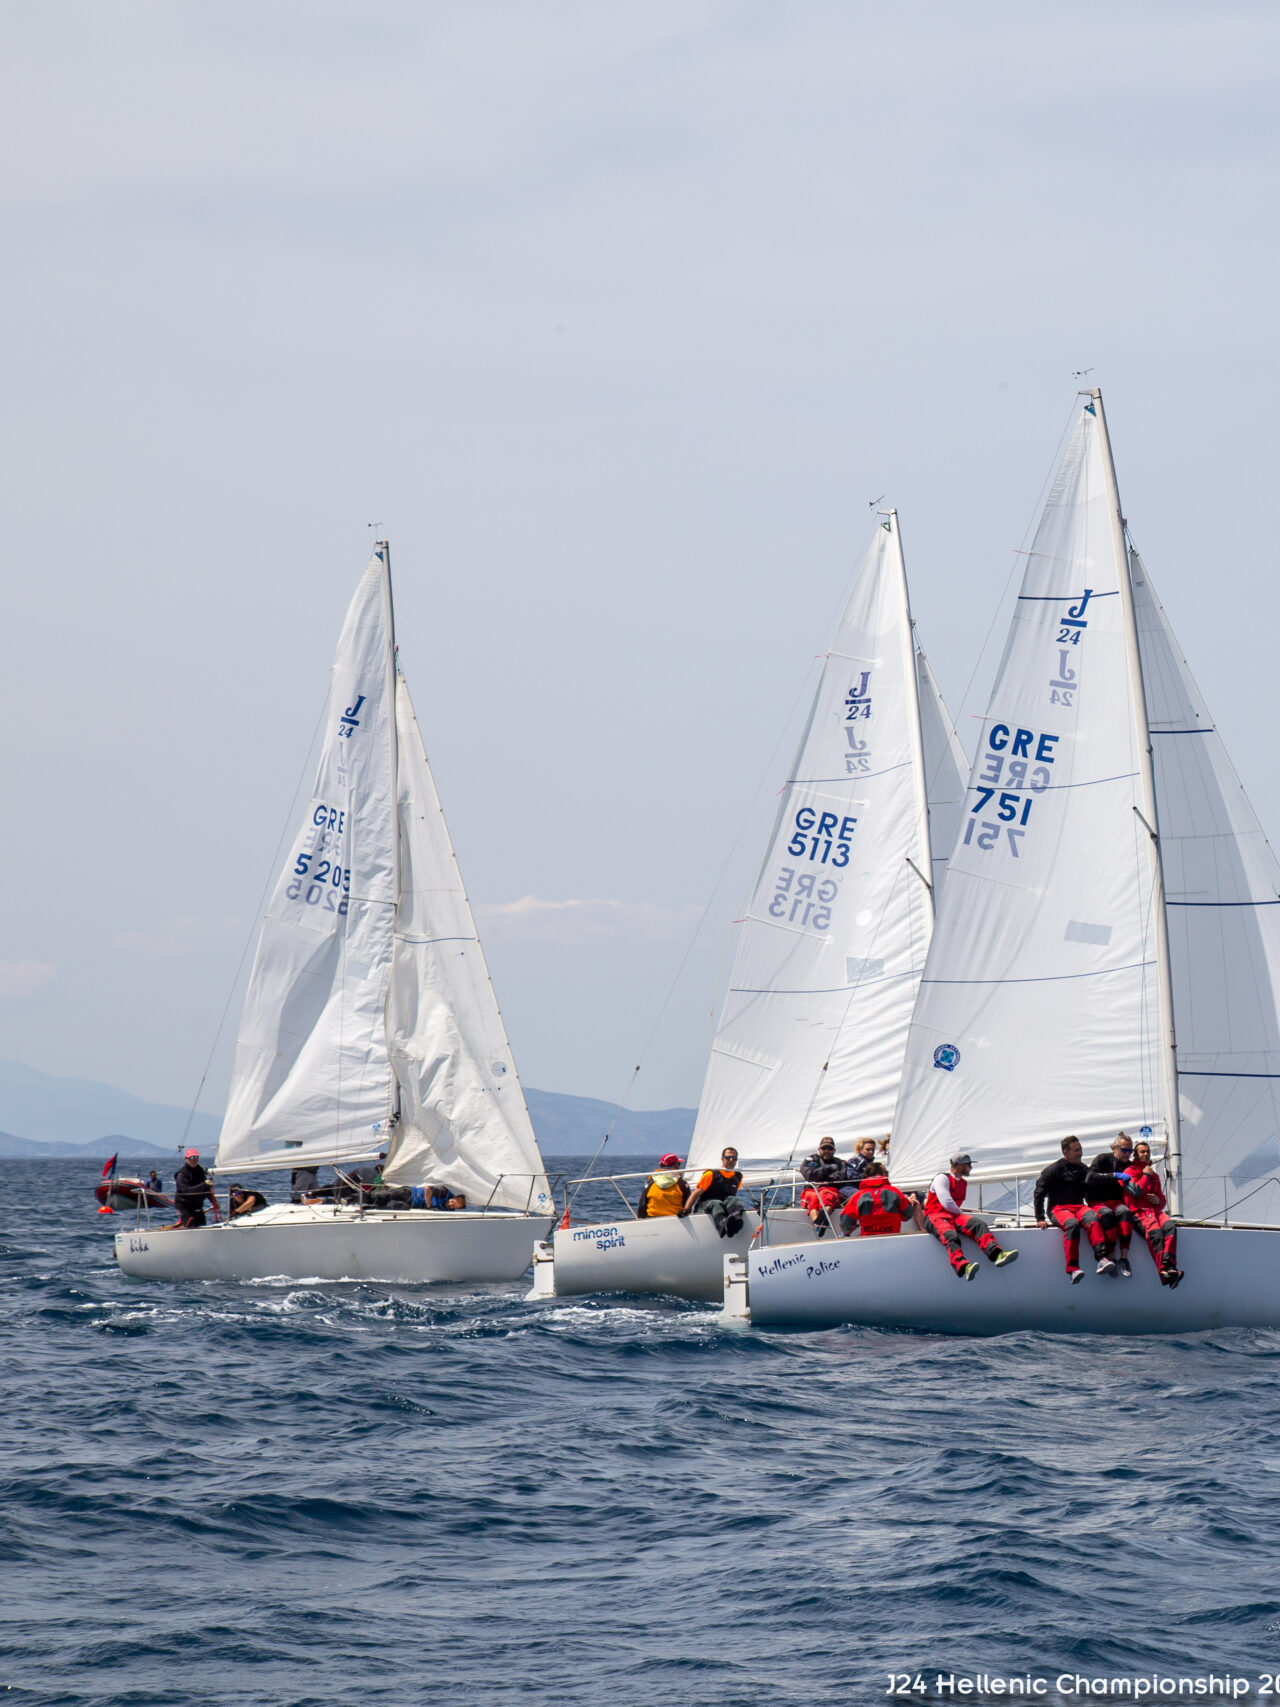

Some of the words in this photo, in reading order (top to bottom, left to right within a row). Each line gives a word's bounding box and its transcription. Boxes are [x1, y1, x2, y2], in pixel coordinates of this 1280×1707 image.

[1067, 589, 1093, 619] J
[1056, 628, 1082, 645] 24
[849, 672, 871, 698] J
[345, 695, 366, 717] J
[845, 704, 872, 720] 24
[338, 725, 354, 738] 24
[989, 723, 1060, 764] GRE
[971, 786, 1033, 826] 751
[313, 805, 345, 834] GRE
[795, 807, 857, 842] GRE
[787, 832, 851, 867] 5113
[294, 853, 351, 891] 5205
[573, 1227, 618, 1241] minoan
[596, 1235, 626, 1251] spirit
[758, 1253, 806, 1278] Hellenic
[806, 1259, 841, 1279] Police
